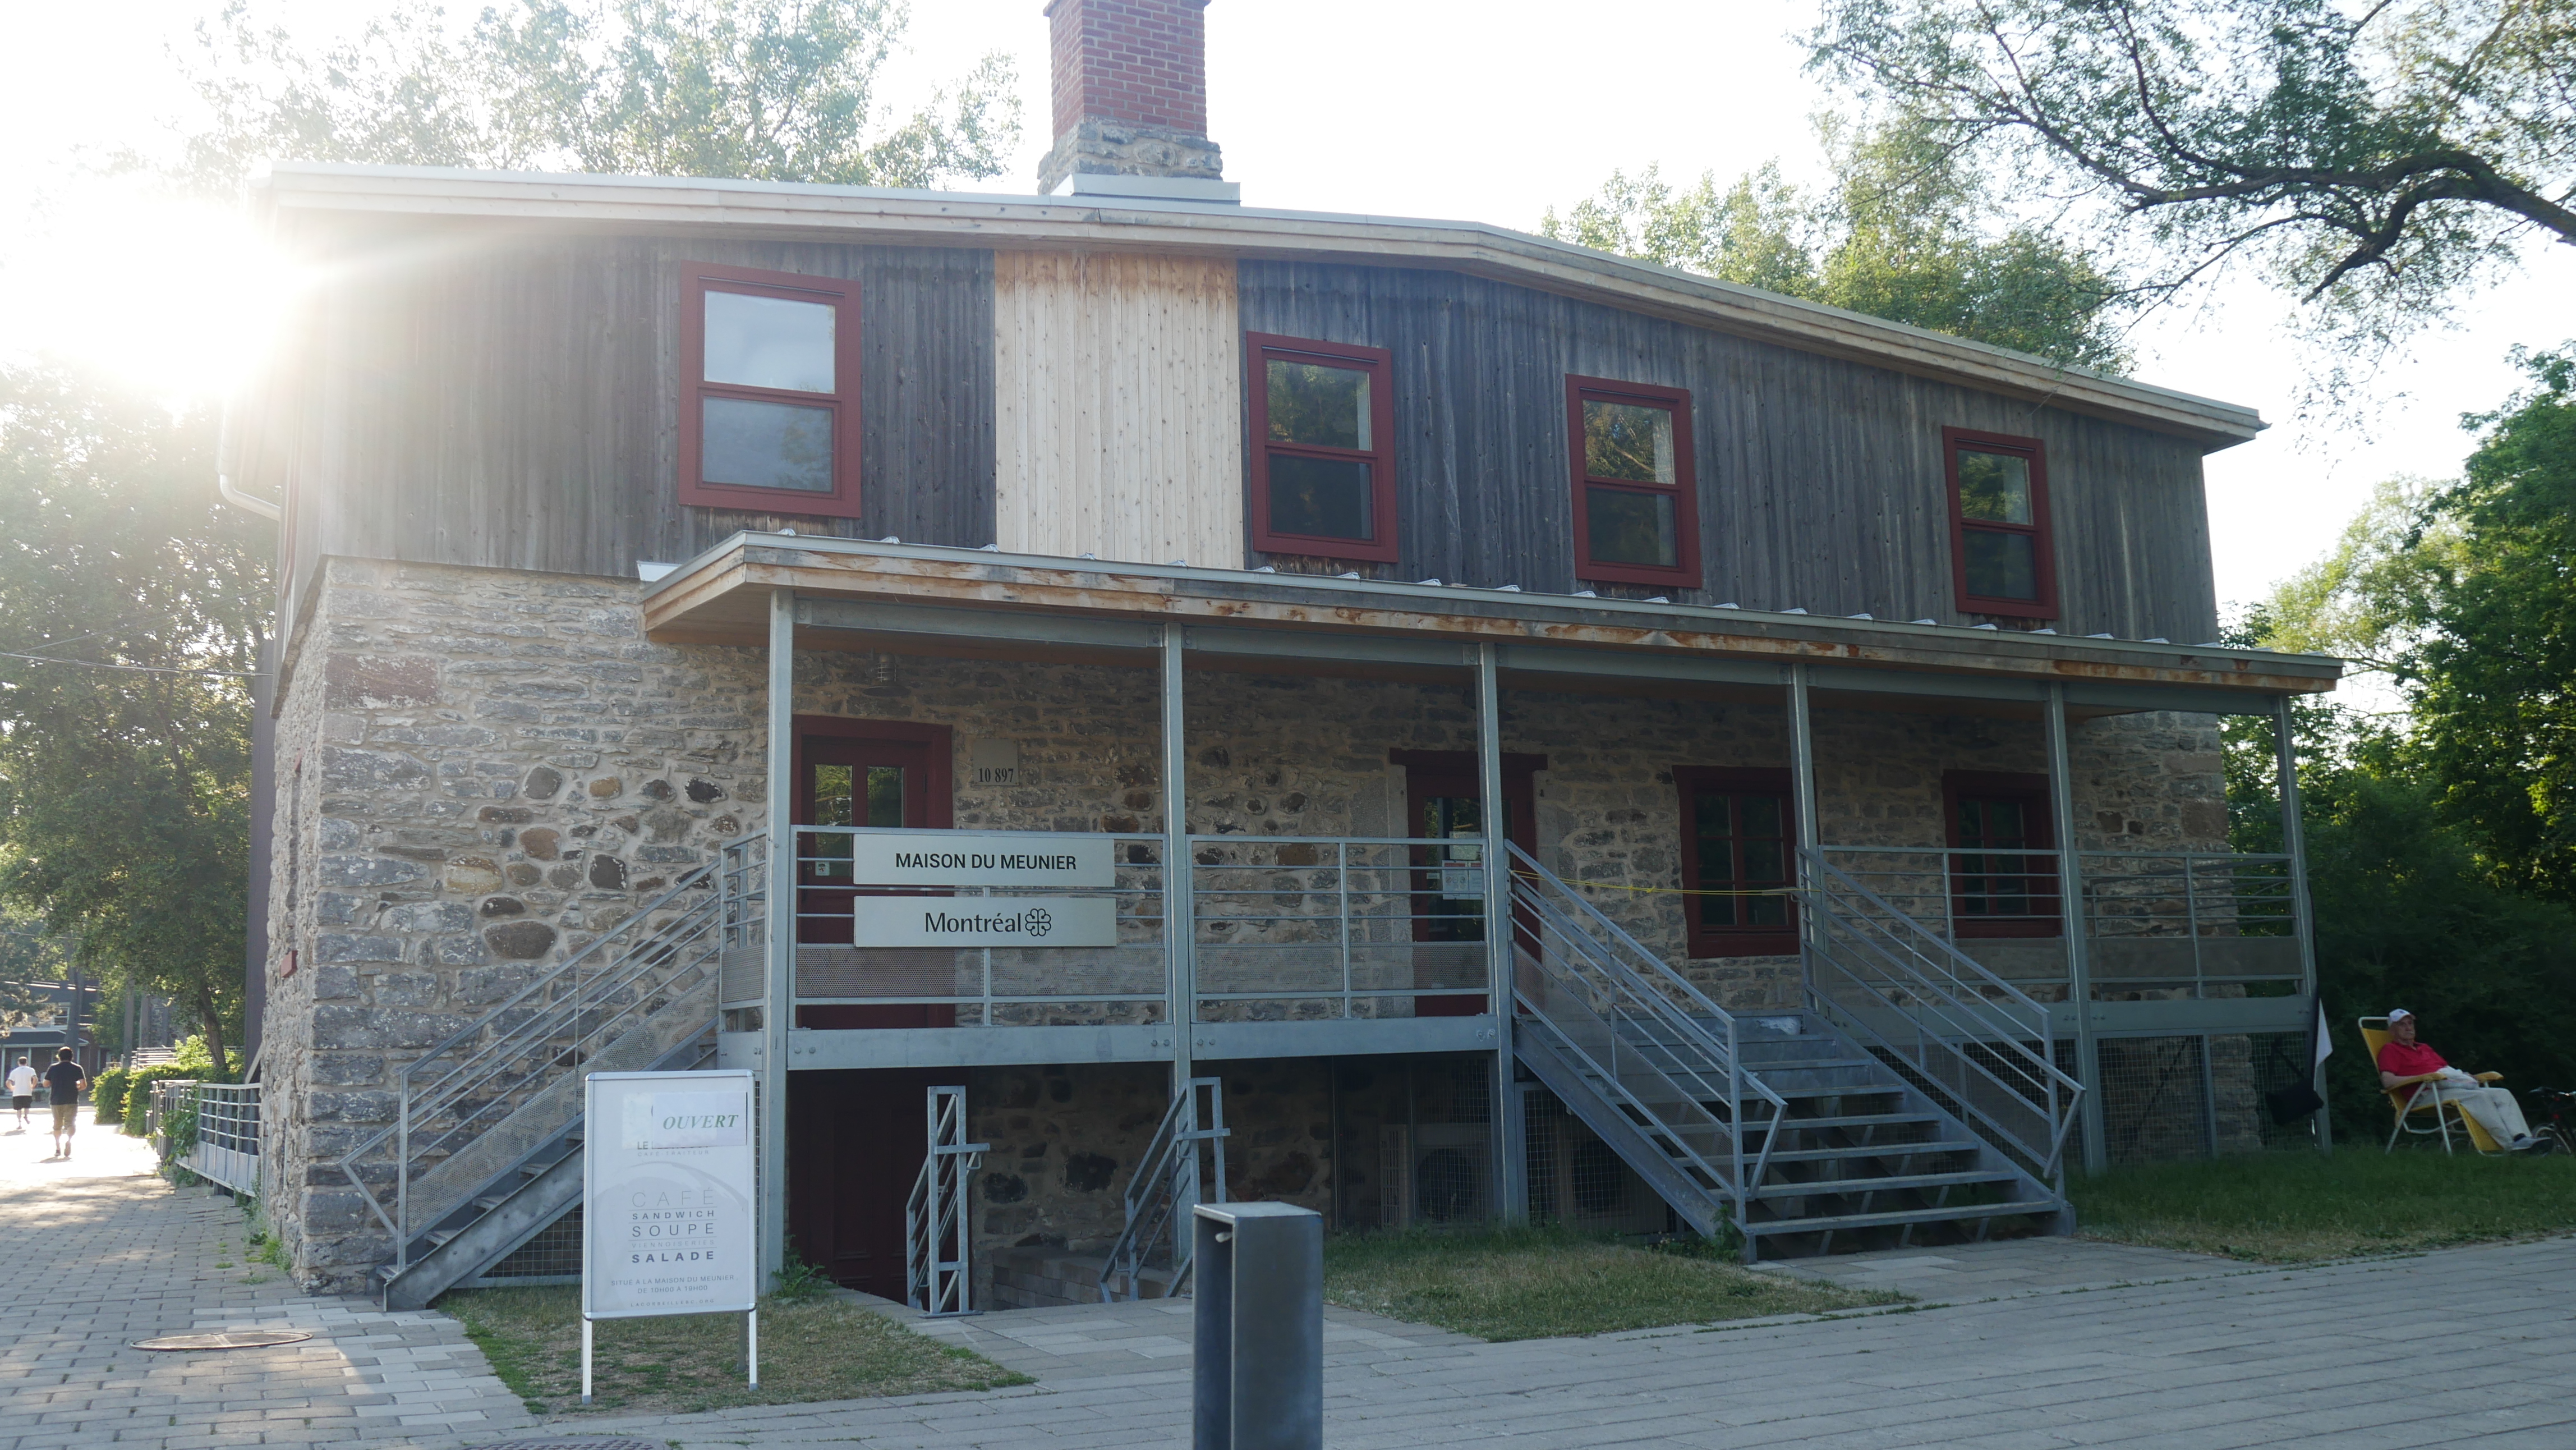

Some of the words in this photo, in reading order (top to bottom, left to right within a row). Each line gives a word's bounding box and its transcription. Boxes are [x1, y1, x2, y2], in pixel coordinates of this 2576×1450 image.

[978, 768, 991, 782] 10
[995, 768, 1014, 783] 897
[895, 852, 966, 869] MAISON
[972, 854, 995, 869] DU
[1001, 854, 1077, 870] MEUNIER
[925, 912, 1021, 933] Montréal
[663, 1114, 739, 1130] OUVERT
[637, 1140, 648, 1150] LE
[632, 1187, 714, 1208] CAFÉ
[632, 1209, 715, 1220] SANDWICH
[632, 1222, 714, 1238] SOUPE
[632, 1239, 715, 1249] VIENNOISERIES
[631, 1250, 714, 1264] SALADE
